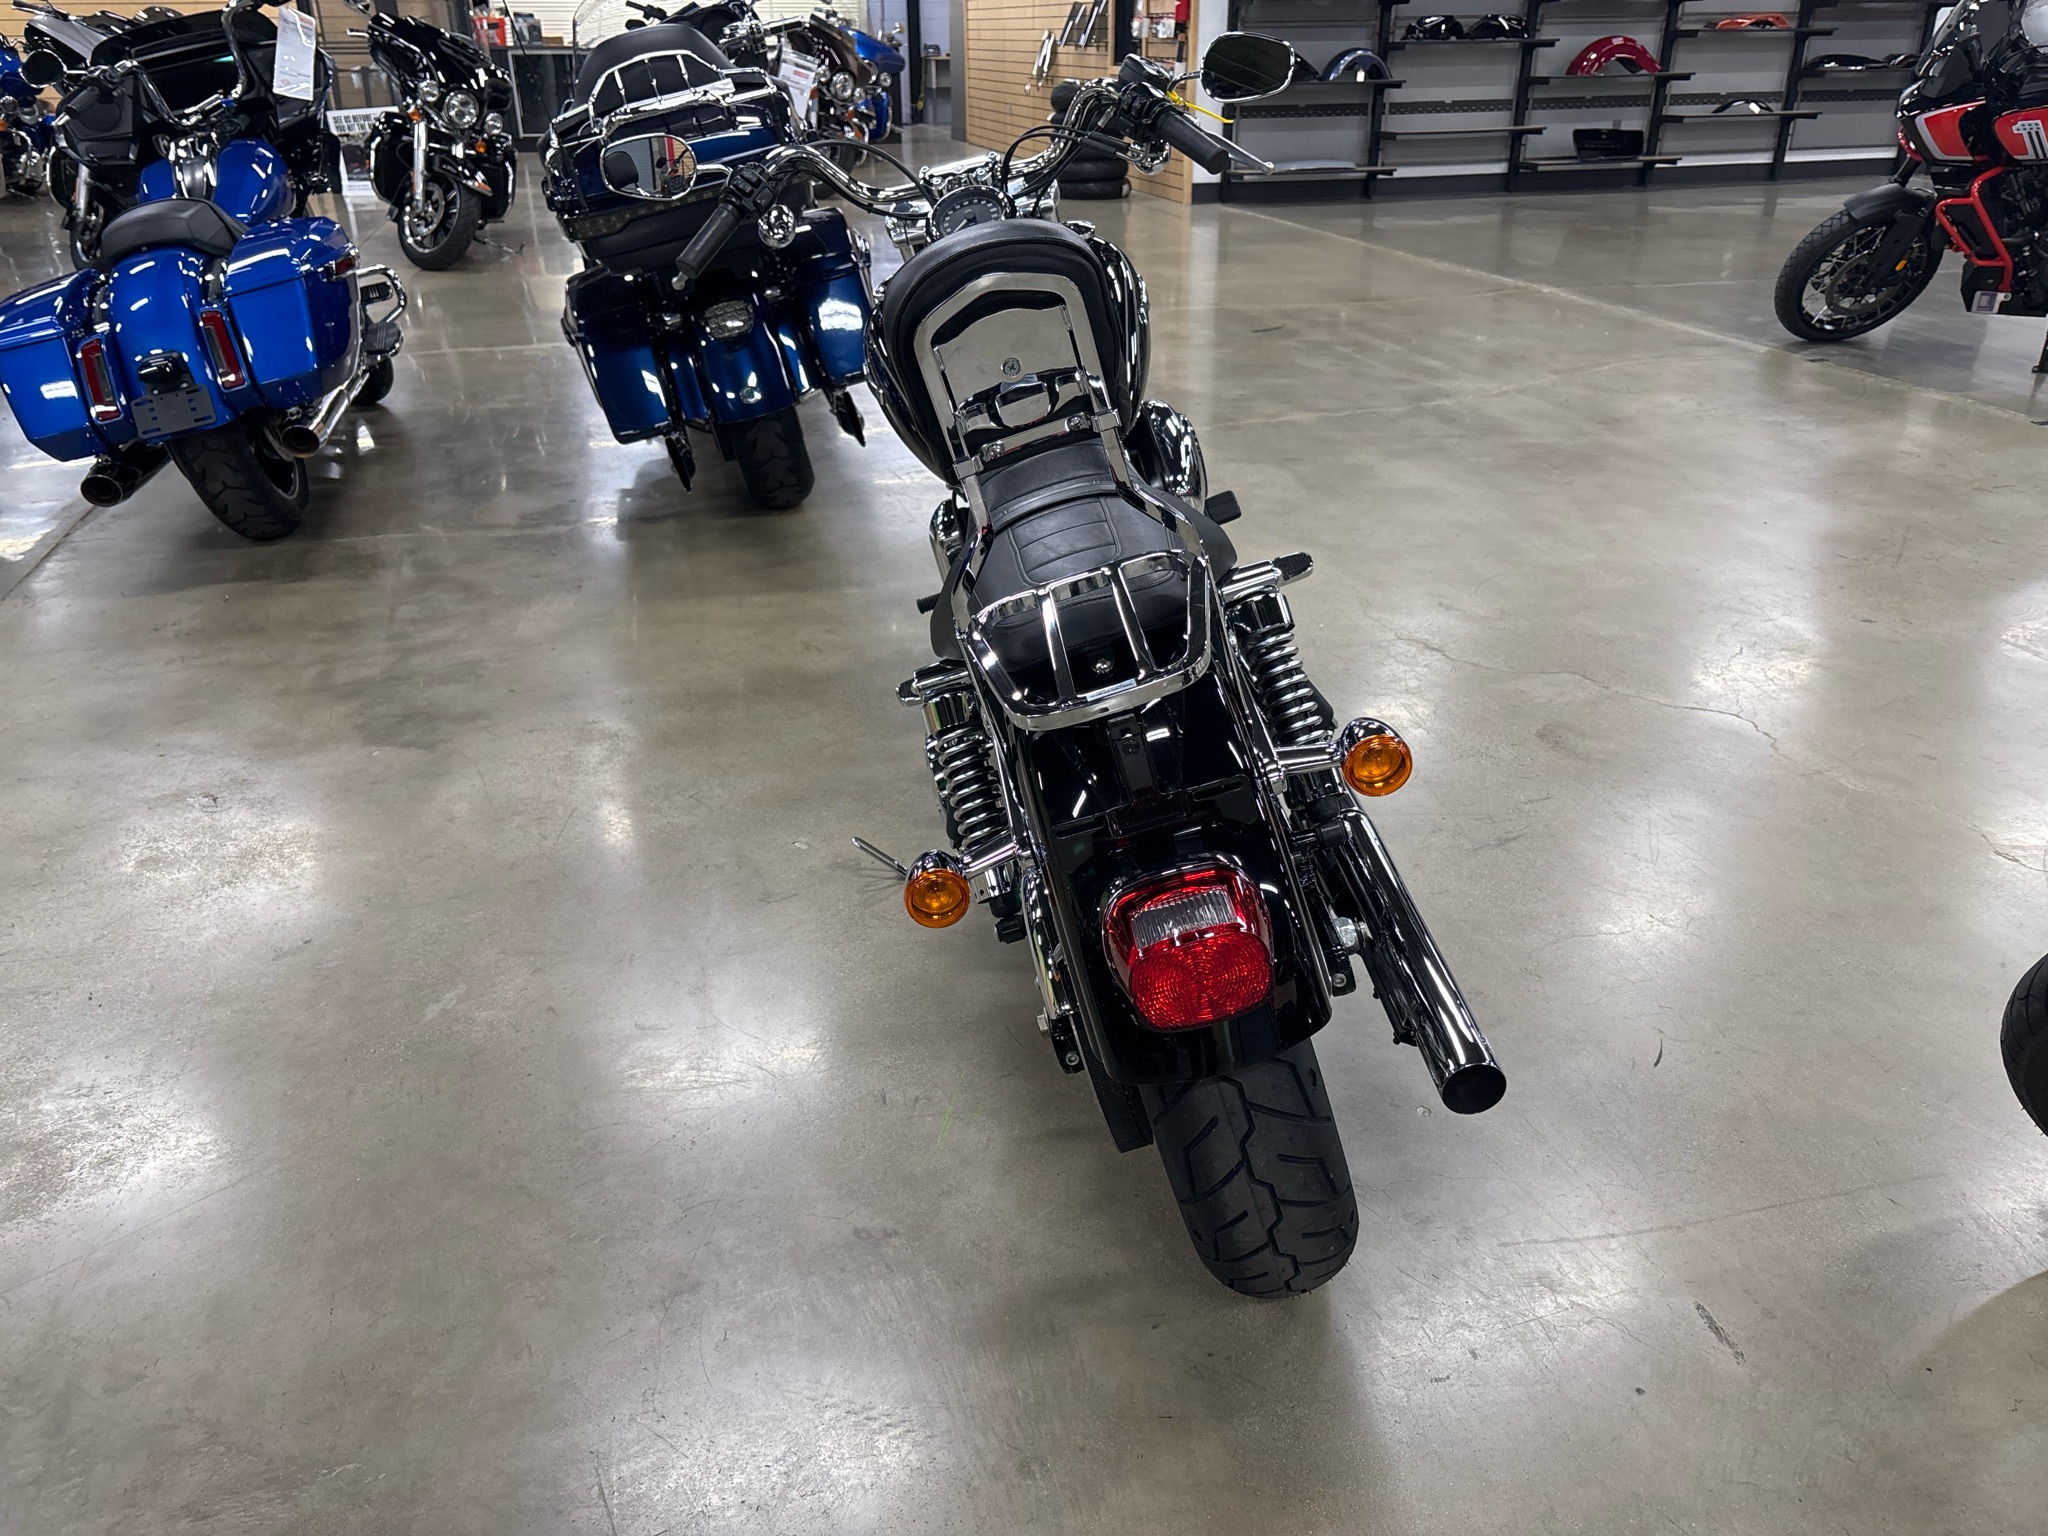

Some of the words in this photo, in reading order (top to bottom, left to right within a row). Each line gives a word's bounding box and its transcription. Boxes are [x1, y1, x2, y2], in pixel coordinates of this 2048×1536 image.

[333, 115, 343, 124] SEE
[352, 114, 372, 123] BEFORE
[335, 124, 346, 132] YOU
